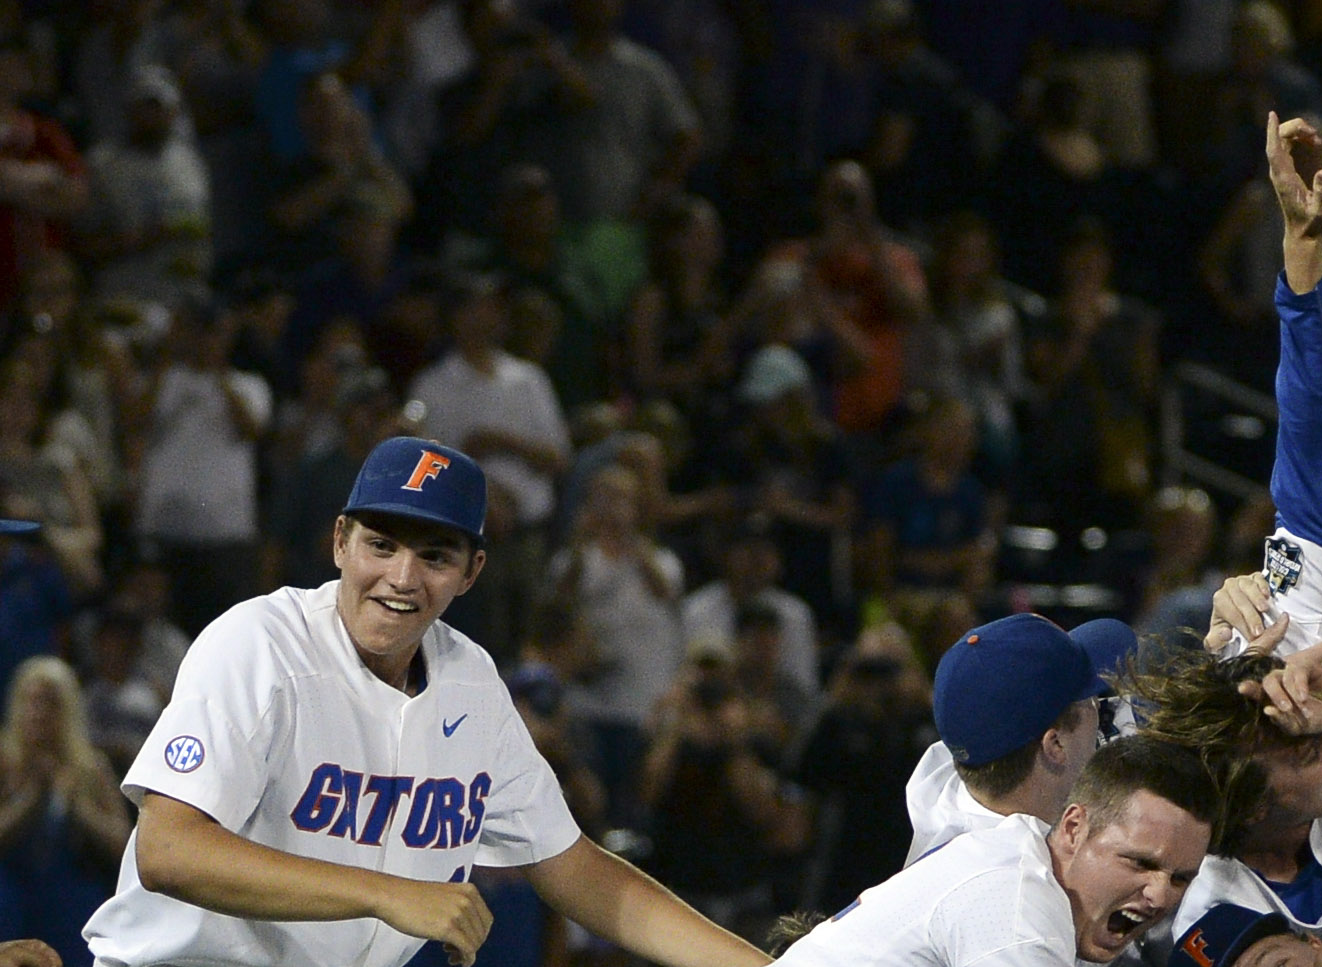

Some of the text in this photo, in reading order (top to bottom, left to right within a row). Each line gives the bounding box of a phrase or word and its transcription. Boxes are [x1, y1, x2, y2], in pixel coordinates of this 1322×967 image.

[400, 450, 451, 491] F
[166, 737, 202, 771] SEC
[289, 762, 492, 849] GATORS
